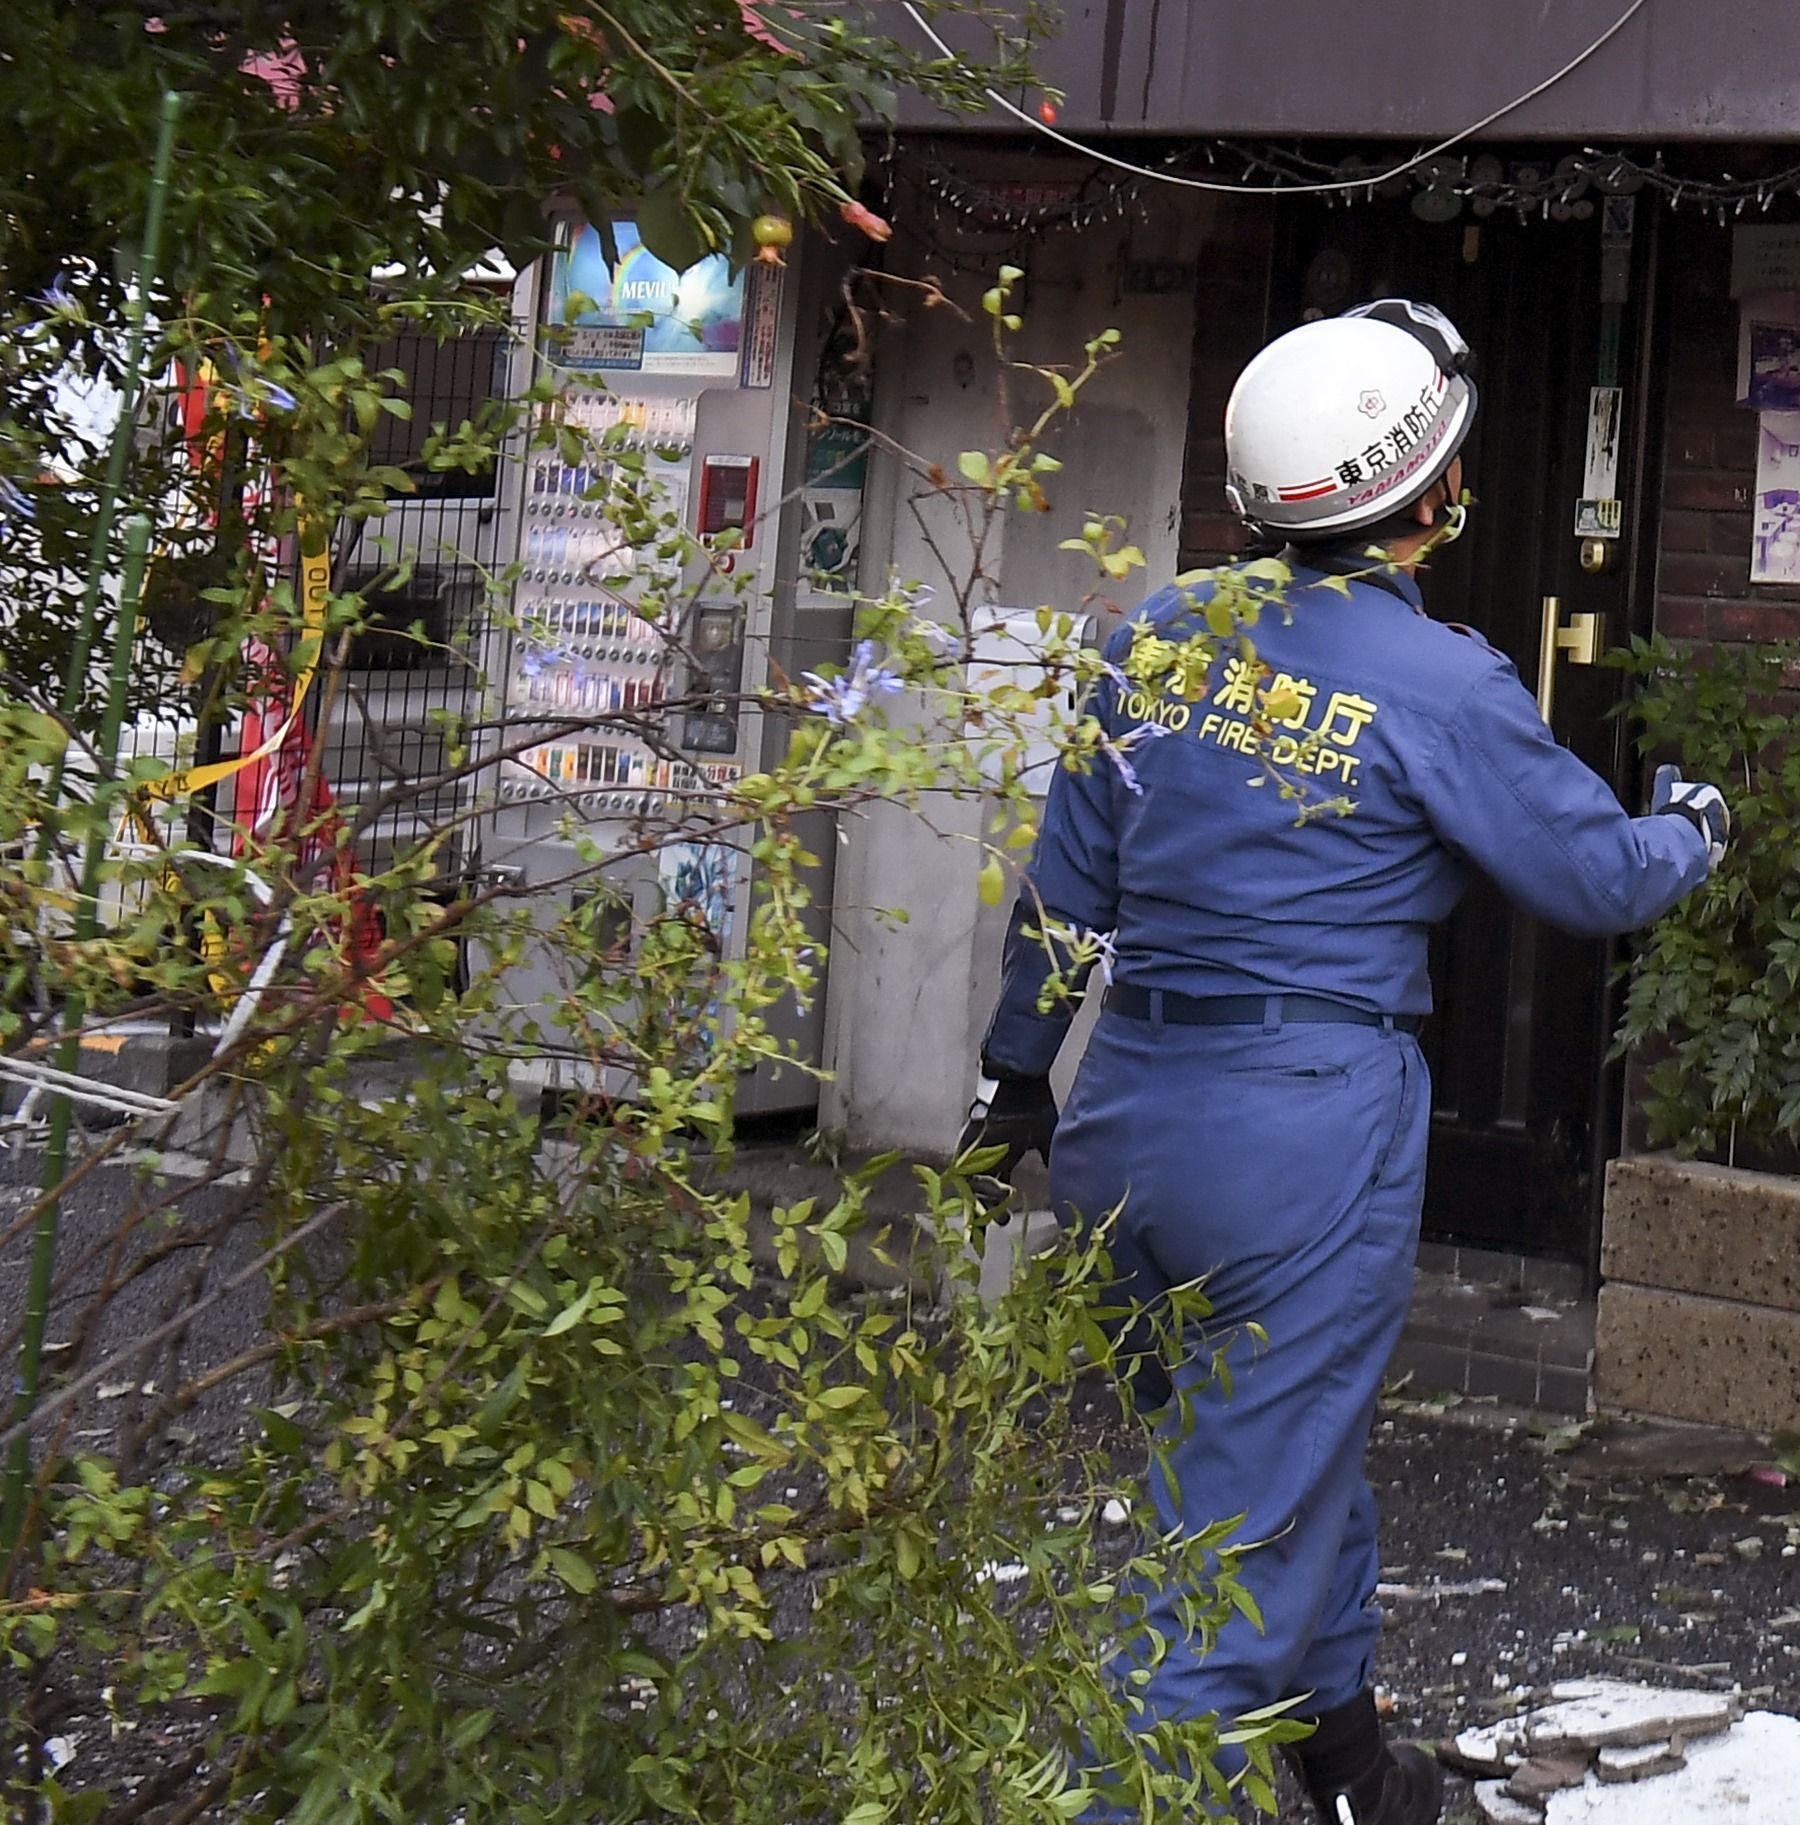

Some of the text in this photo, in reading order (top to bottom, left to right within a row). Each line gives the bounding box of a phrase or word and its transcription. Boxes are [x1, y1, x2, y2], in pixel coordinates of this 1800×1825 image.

[1334, 384, 1443, 488] 東京消防庁
[1115, 687, 1361, 786] TOKYO FIRE DEPT.
